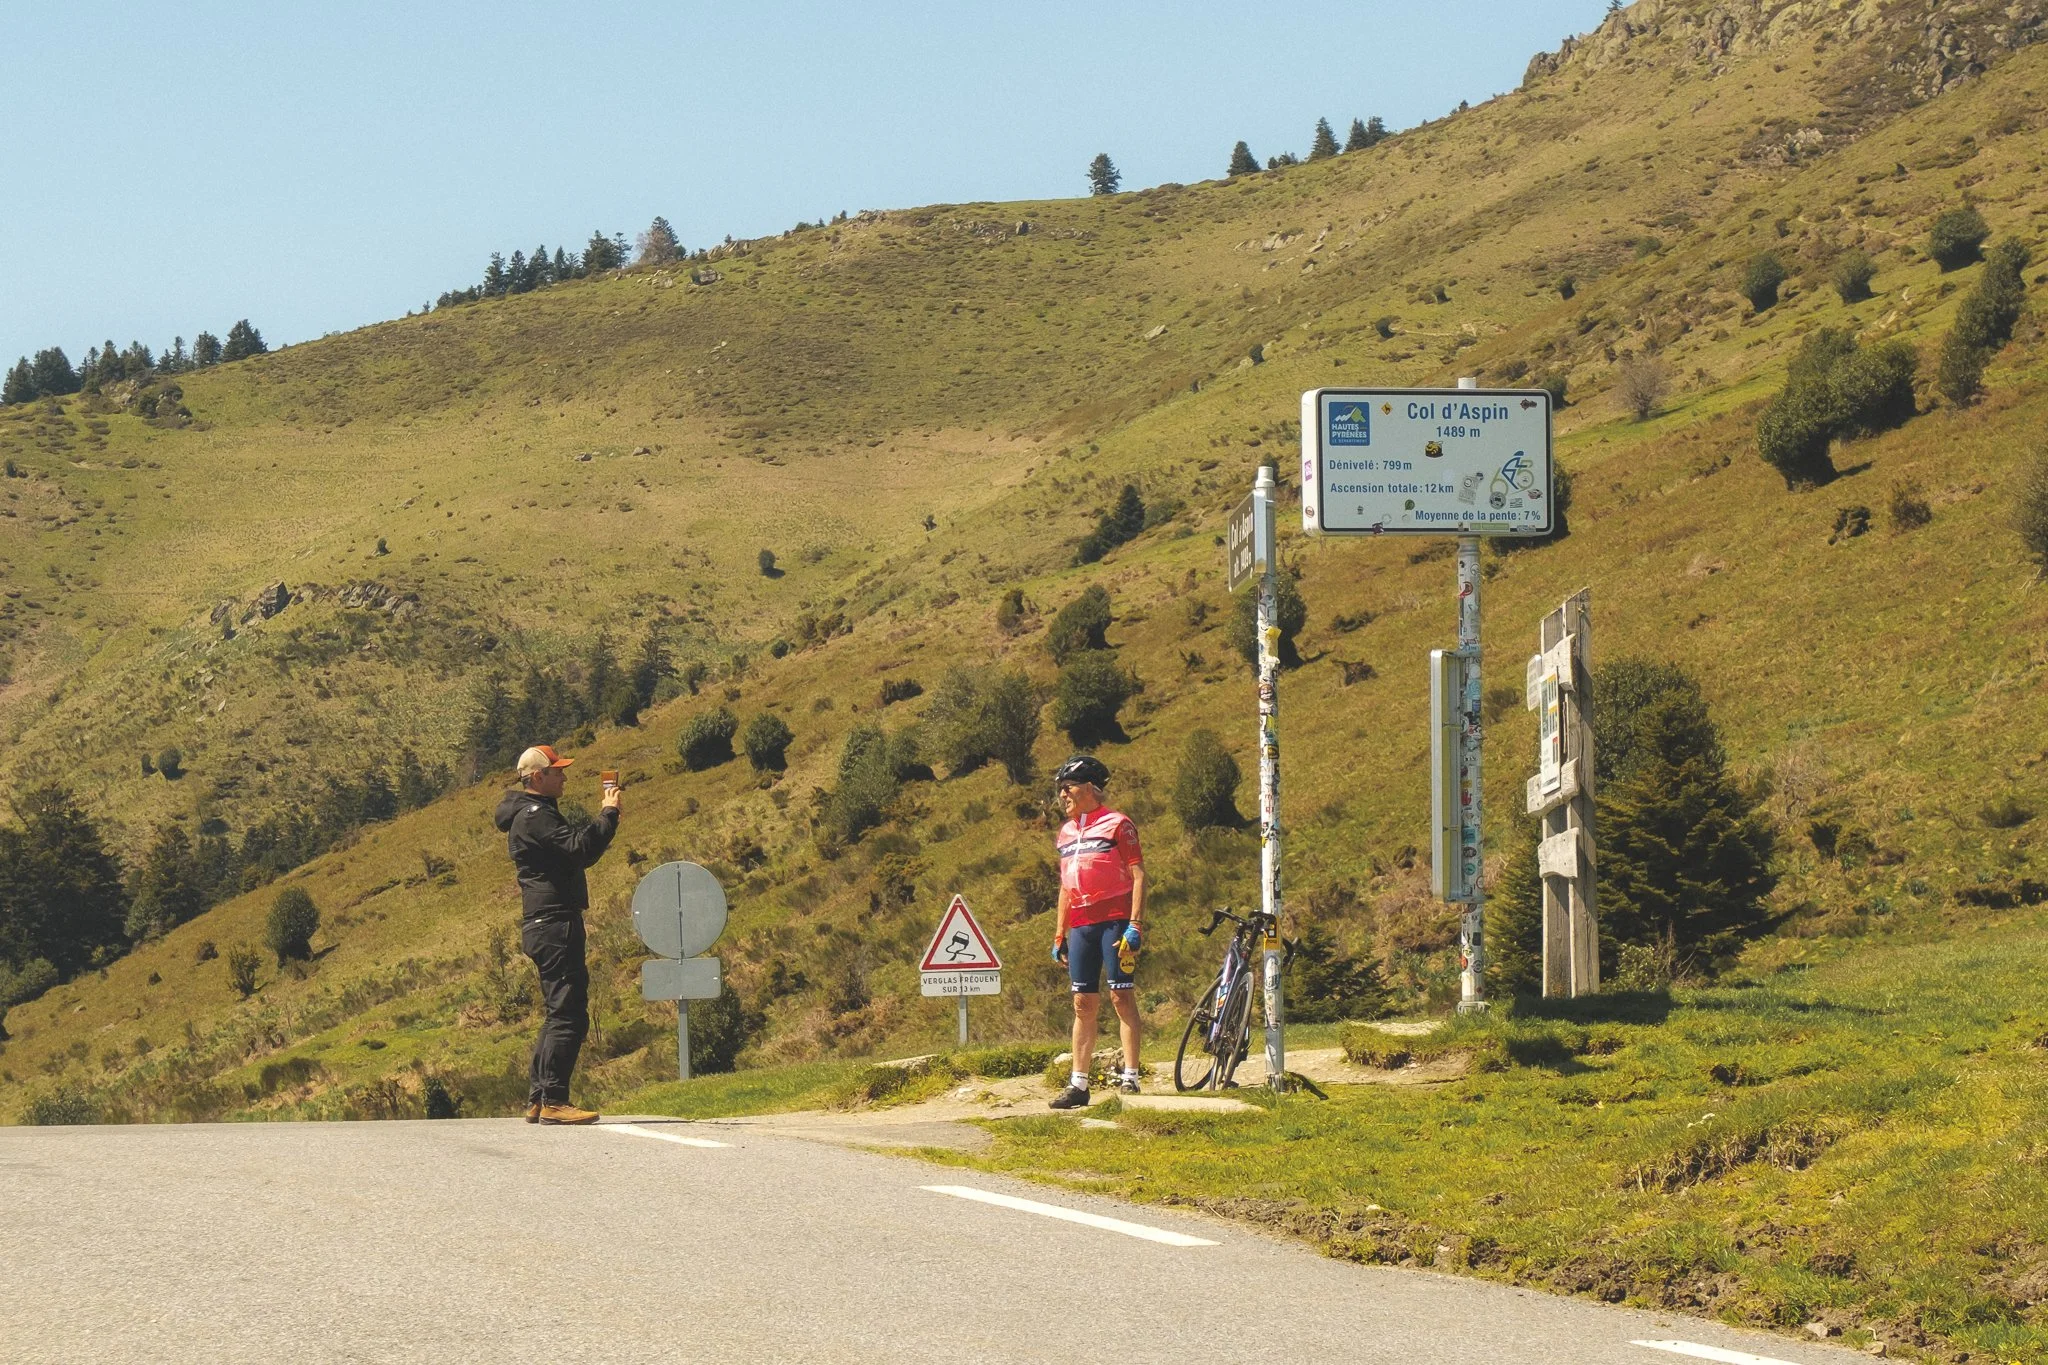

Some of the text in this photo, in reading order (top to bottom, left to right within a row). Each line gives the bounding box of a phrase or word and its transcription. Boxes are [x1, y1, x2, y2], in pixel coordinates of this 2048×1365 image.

[1407, 402, 1509, 424] Col d'Aspin
[1331, 423, 1360, 431] HAUTES
[1436, 425, 1481, 438] 1489 m
[1330, 482, 1384, 494] Ascension
[1415, 510, 1460, 523] Moyenne
[1462, 510, 1474, 521] de
[1477, 510, 1487, 521] la
[923, 975, 998, 984] VERGLAS FRÉQUENT
[970, 985, 981, 993] km
